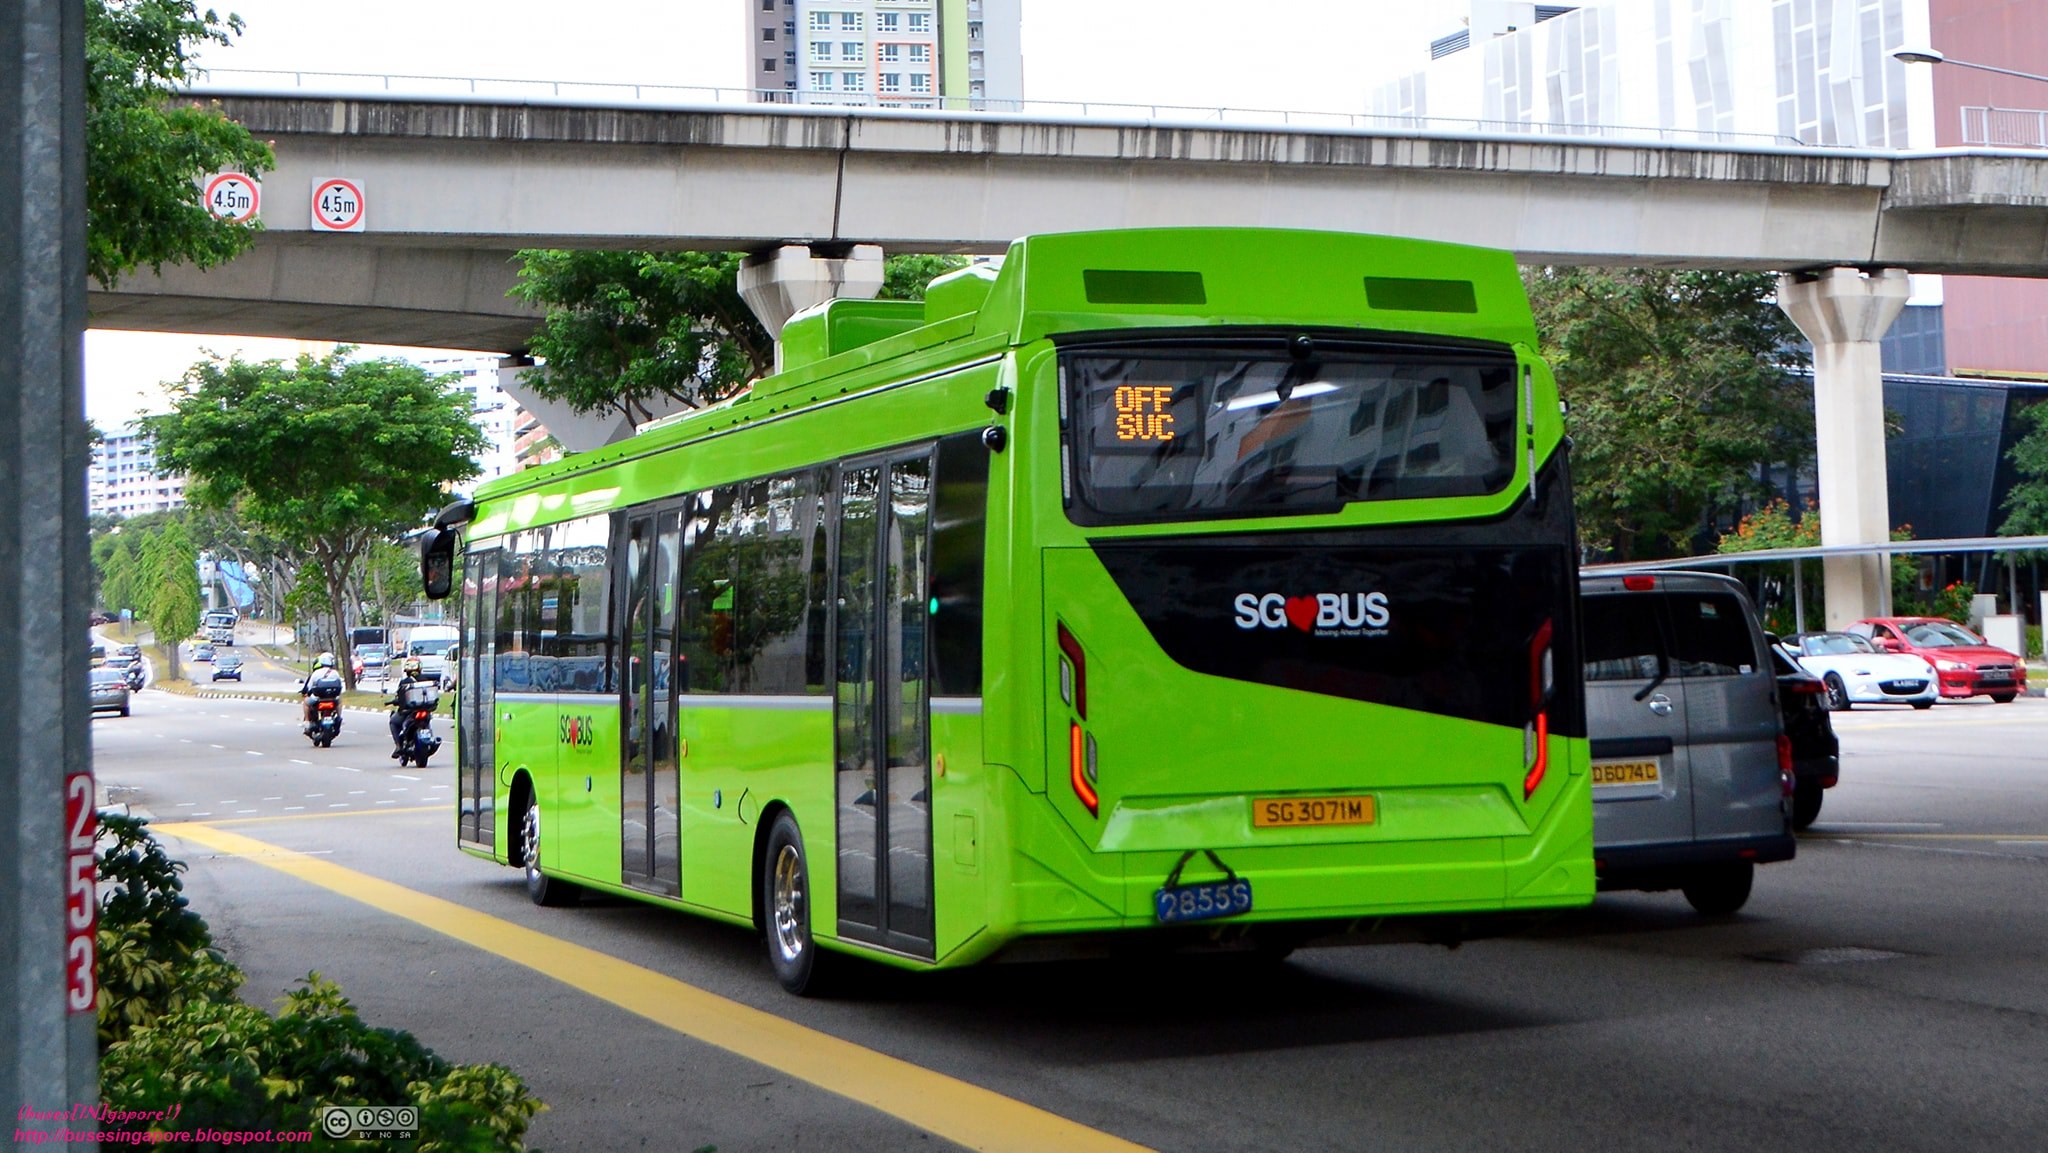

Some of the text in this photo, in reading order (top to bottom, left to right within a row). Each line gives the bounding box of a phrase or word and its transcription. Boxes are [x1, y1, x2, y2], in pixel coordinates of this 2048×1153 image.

[214, 190, 249, 209] 4.5m
[322, 195, 355, 213] 4.5m
[1115, 386, 1173, 412] OFF
[1116, 414, 1175, 440] SUC
[1266, 800, 1362, 823] SG3071M
[69, 774, 94, 1010] 253
